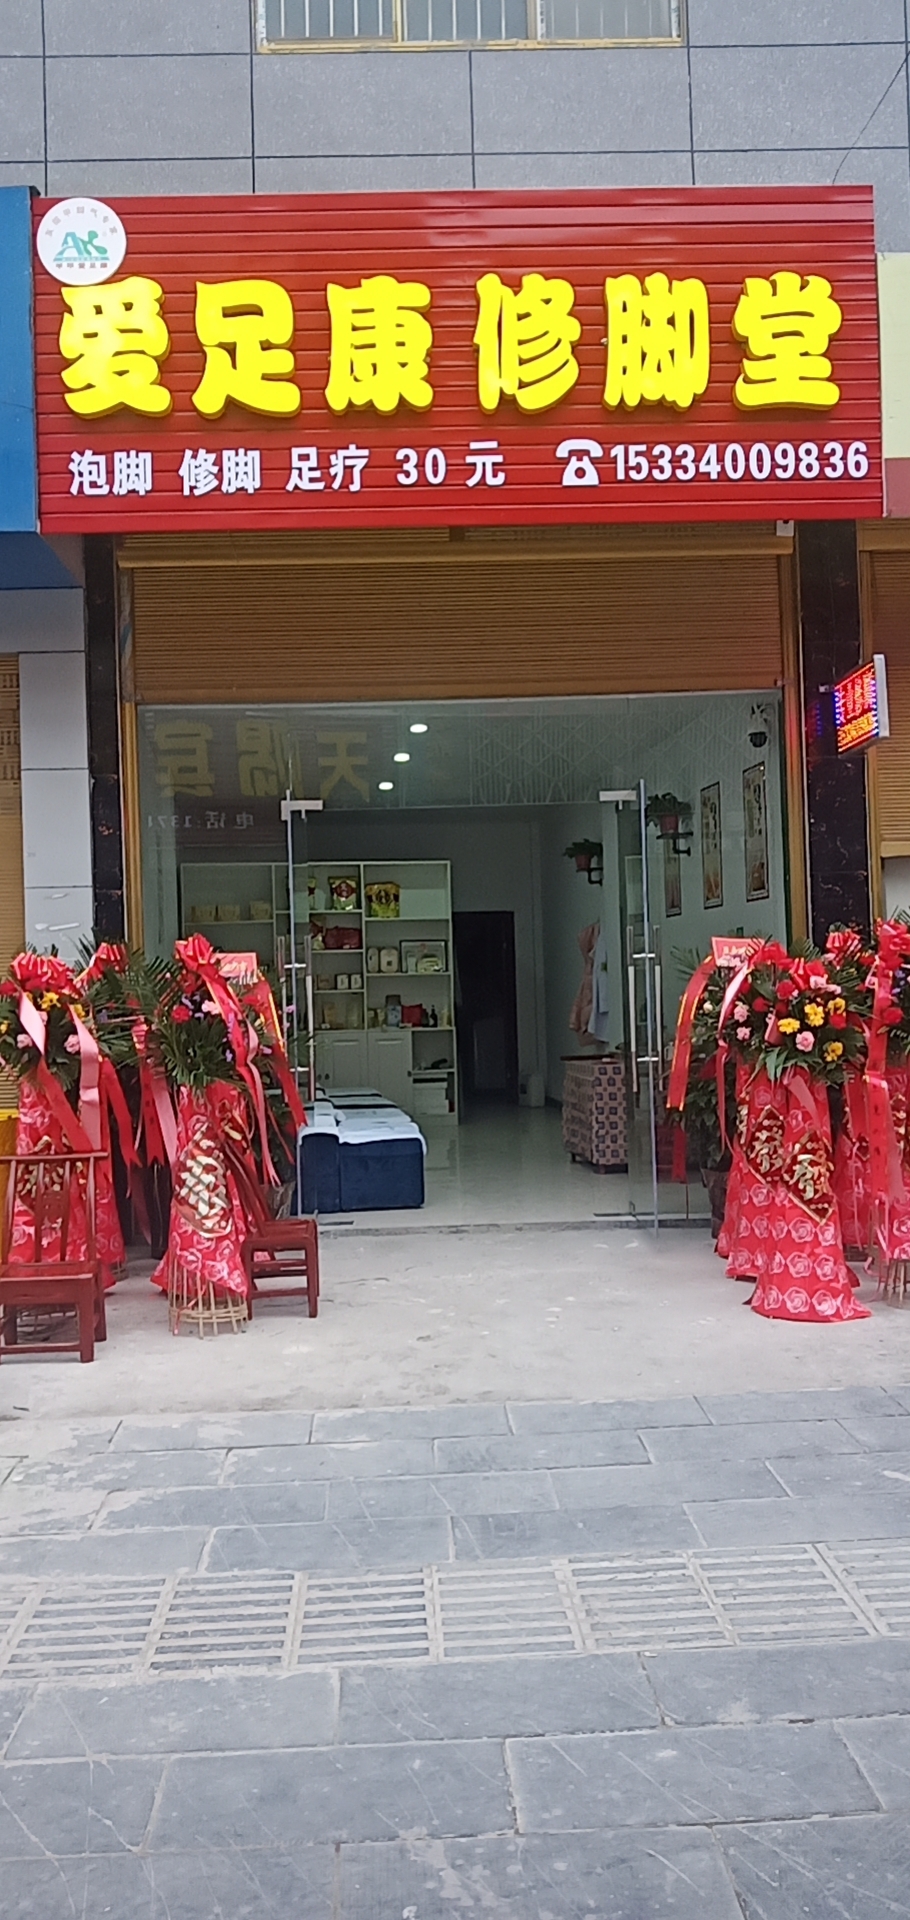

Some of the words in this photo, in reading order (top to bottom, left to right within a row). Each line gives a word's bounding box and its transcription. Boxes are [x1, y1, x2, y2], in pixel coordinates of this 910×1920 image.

[59, 271, 842, 416] 爱足康修脚堂
[69, 450, 151, 495] 泡脚
[179, 449, 260, 495] 修脚
[286, 445, 368, 491] 足疗
[397, 448, 445, 484] 30
[466, 442, 504, 486] 元
[611, 442, 867, 480] 15334009836
